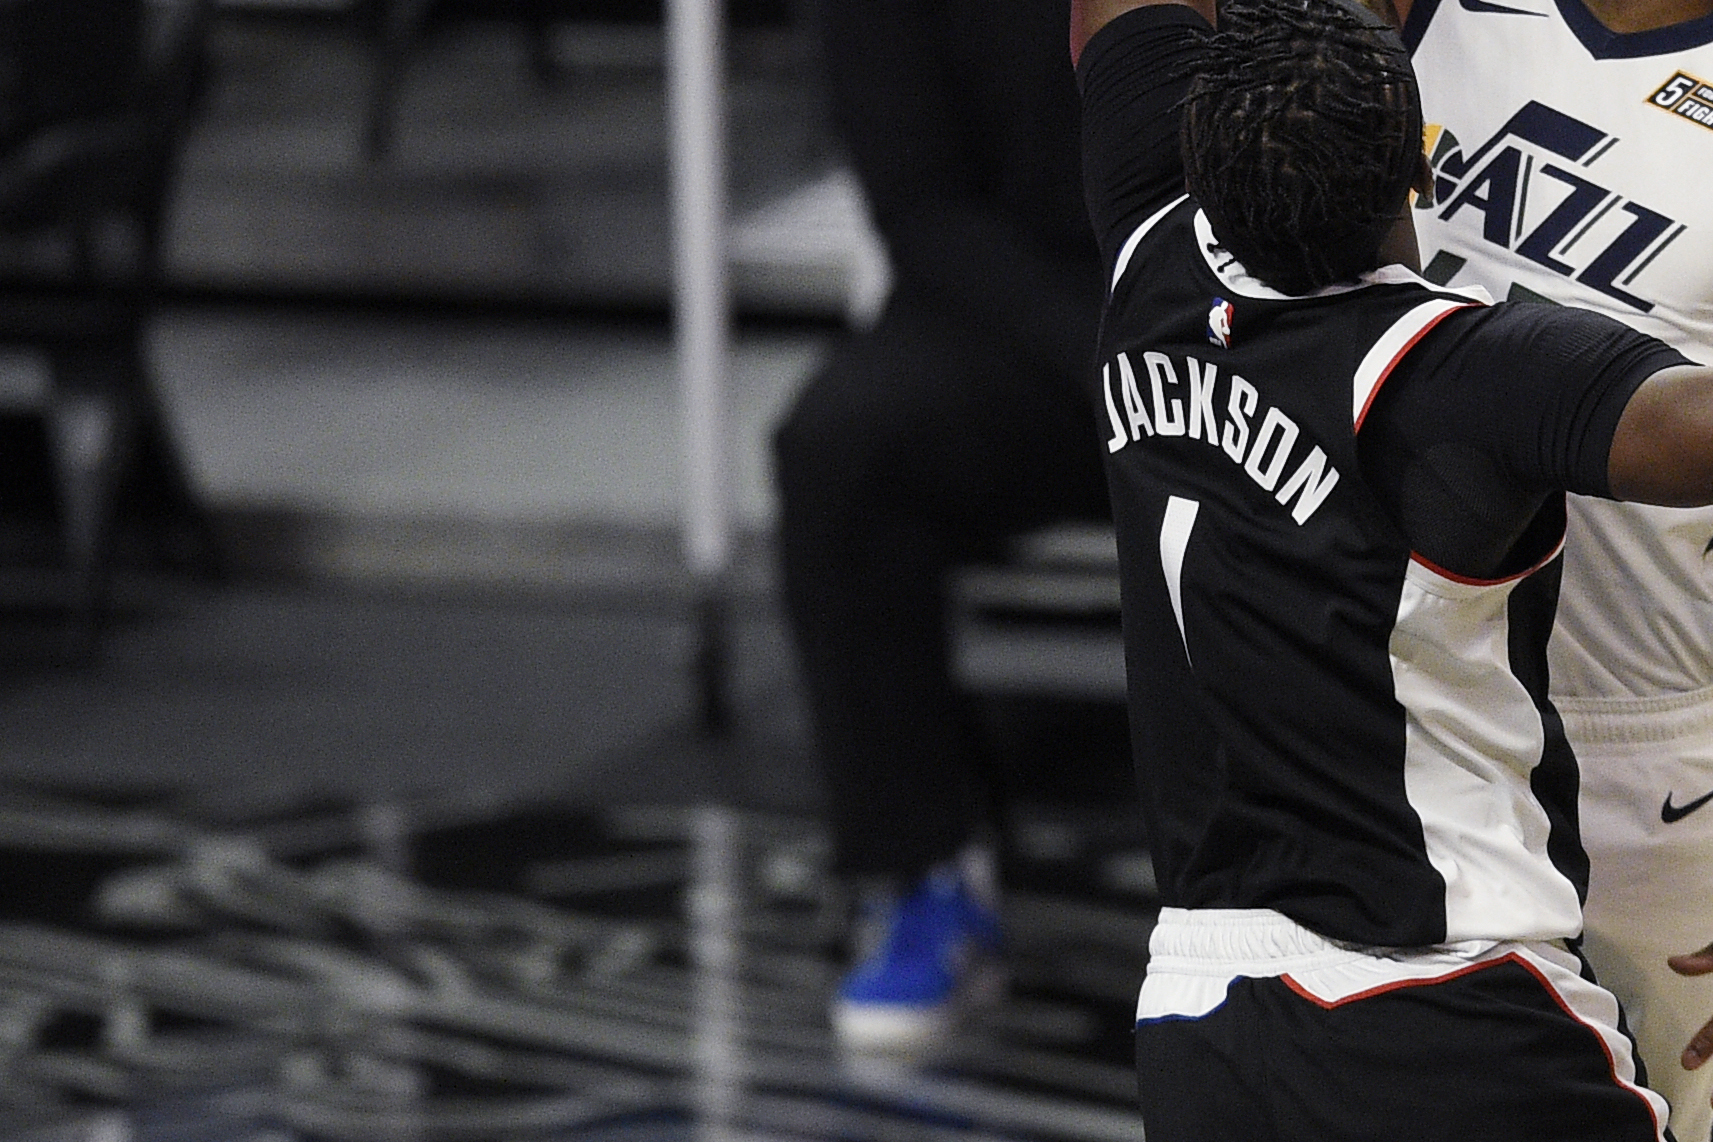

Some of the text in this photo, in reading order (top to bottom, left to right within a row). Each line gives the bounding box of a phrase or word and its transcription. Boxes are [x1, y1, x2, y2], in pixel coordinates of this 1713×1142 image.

[1655, 75, 1694, 107] 5
[1102, 351, 1341, 526] JACKSON
[1159, 495, 1200, 669] 1
